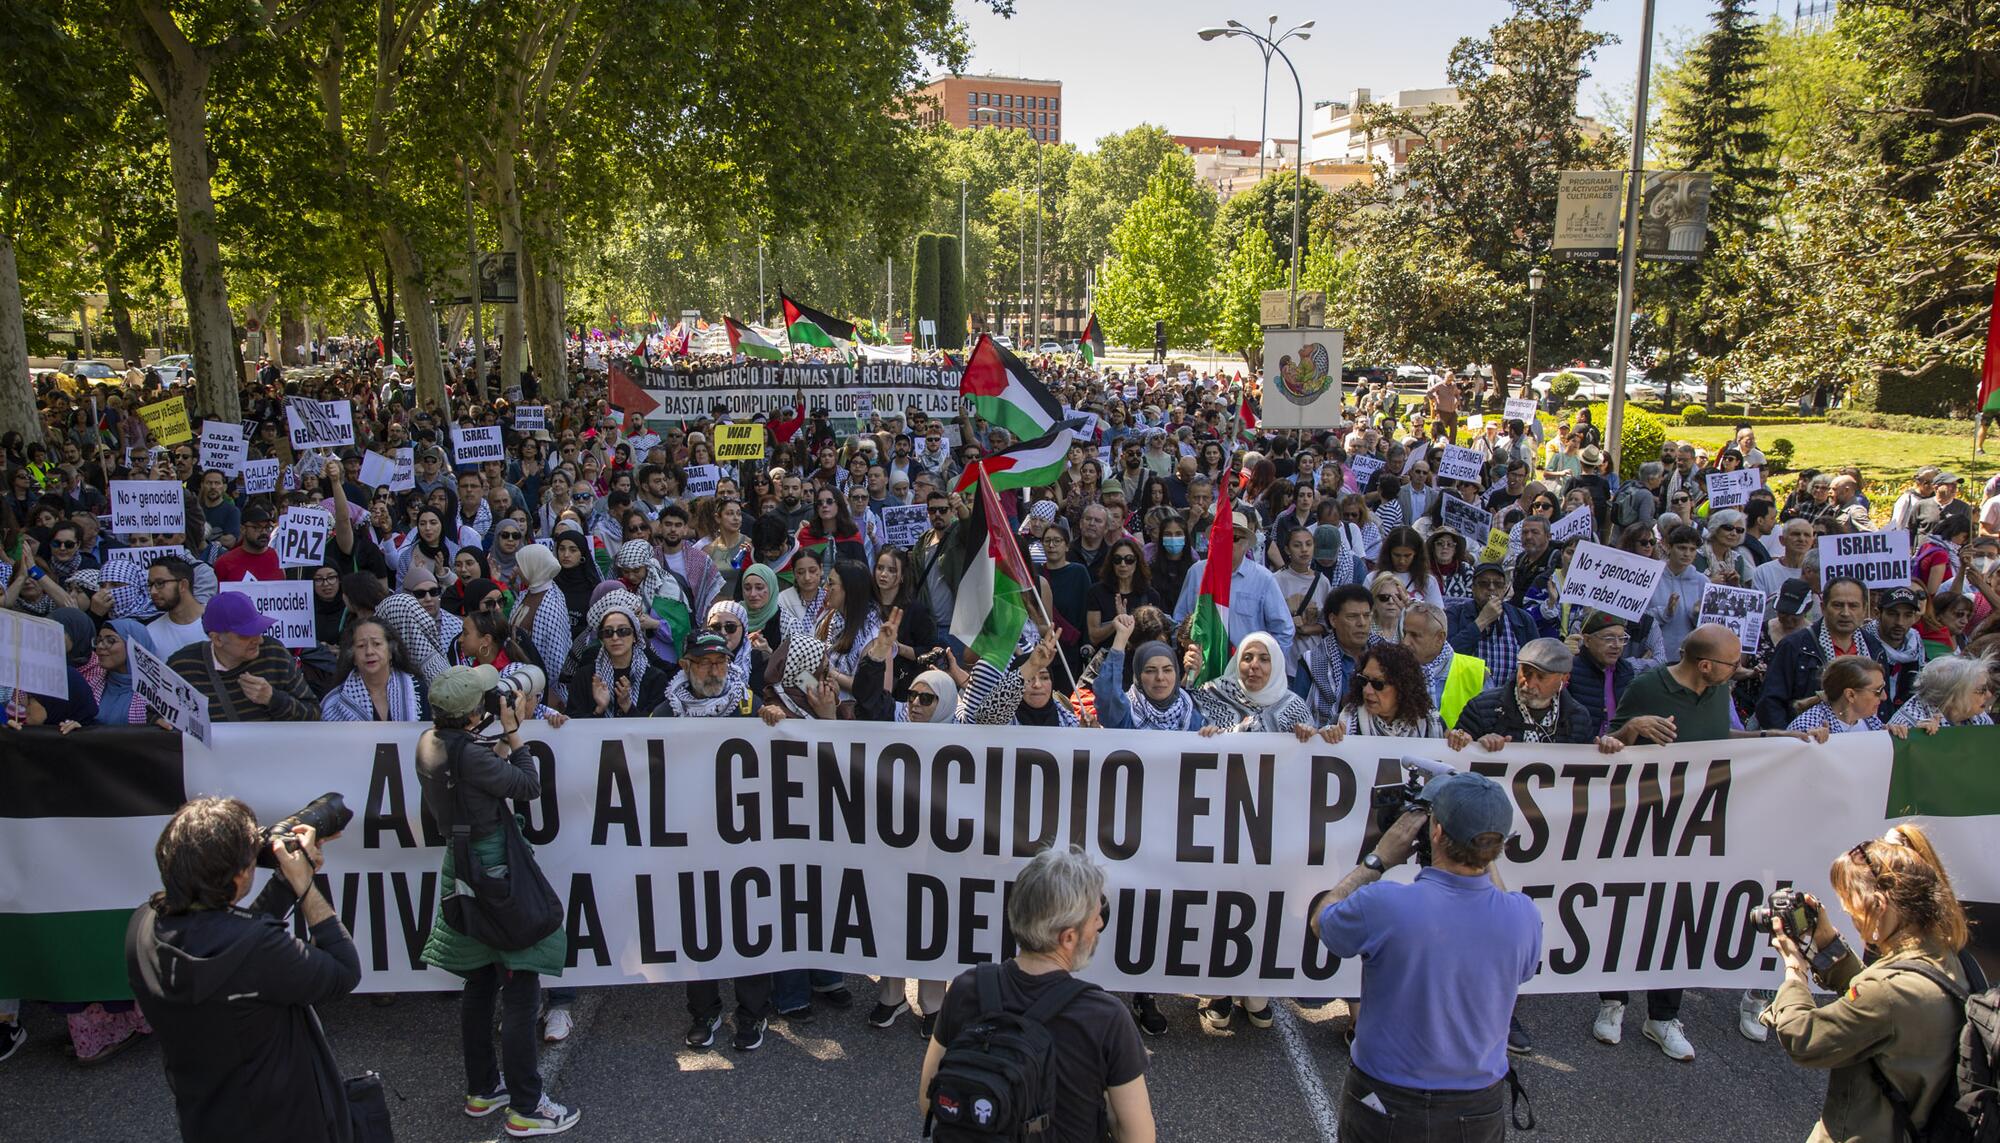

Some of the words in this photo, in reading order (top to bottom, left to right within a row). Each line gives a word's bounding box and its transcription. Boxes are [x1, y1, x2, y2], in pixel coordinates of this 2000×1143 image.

[1566, 192, 1613, 200] CULTURALES
[1571, 185, 1619, 193] ACTIVIDADES
[645, 371, 666, 388] FIN
[669, 374, 693, 389] DEL
[695, 366, 759, 389] COMERCIO
[763, 366, 780, 385] DE
[782, 368, 828, 386] ARMAS
[832, 368, 840, 386] Y
[843, 368, 860, 385] DE
[862, 366, 938, 386] RELACIONES
[665, 394, 704, 415] BASTA
[810, 394, 832, 412] DEL
[835, 393, 893, 412] GOBRNO
[896, 394, 905, 412] Y
[926, 394, 948, 412] LAS
[209, 433, 234, 442] GAZA
[462, 428, 493, 442] ISRAEL,
[727, 426, 752, 439] WAR
[202, 442, 220, 450] YOU
[221, 443, 240, 452] ARE
[457, 444, 502, 460] GENOCIDA!
[717, 443, 762, 457] CRIMES!
[210, 452, 230, 460] NOT
[1457, 449, 1484, 465] CRIMEN
[204, 460, 234, 470] ALONE
[245, 465, 279, 479] CALLAR
[688, 467, 708, 479] RAEL,
[1439, 462, 1450, 474] DE
[1450, 464, 1479, 479] GUERRA!
[687, 480, 716, 493] OCIDA!
[118, 489, 130, 505] No
[139, 489, 180, 510] genocide!
[114, 512, 140, 529] Jews,
[141, 511, 161, 528] rebel
[163, 512, 184, 527] now!
[289, 513, 325, 527] JUSTA
[1580, 514, 1591, 527] ES
[285, 528, 324, 561] PAZ
[1836, 534, 1893, 556] ISRAEL,
[1576, 551, 1593, 570] No
[1600, 562, 1656, 589] genocide!
[1825, 560, 1908, 582] GENOCIDA!
[257, 592, 309, 614] genocide!
[1562, 577, 1587, 600] Jews,
[1588, 585, 1619, 607] rebel
[1616, 594, 1648, 614] now!
[287, 620, 313, 639] now!
[136, 679, 180, 724] ¡BOICOT!
[363, 740, 560, 848] AO
[590, 738, 688, 847] AL
[715, 737, 1145, 859] GENOCIDIO
[1176, 752, 1274, 865] EN
[1307, 755, 1732, 866] PSTINA
[635, 864, 879, 964] LUCHA
[1099, 888, 1342, 981] UEBLO
